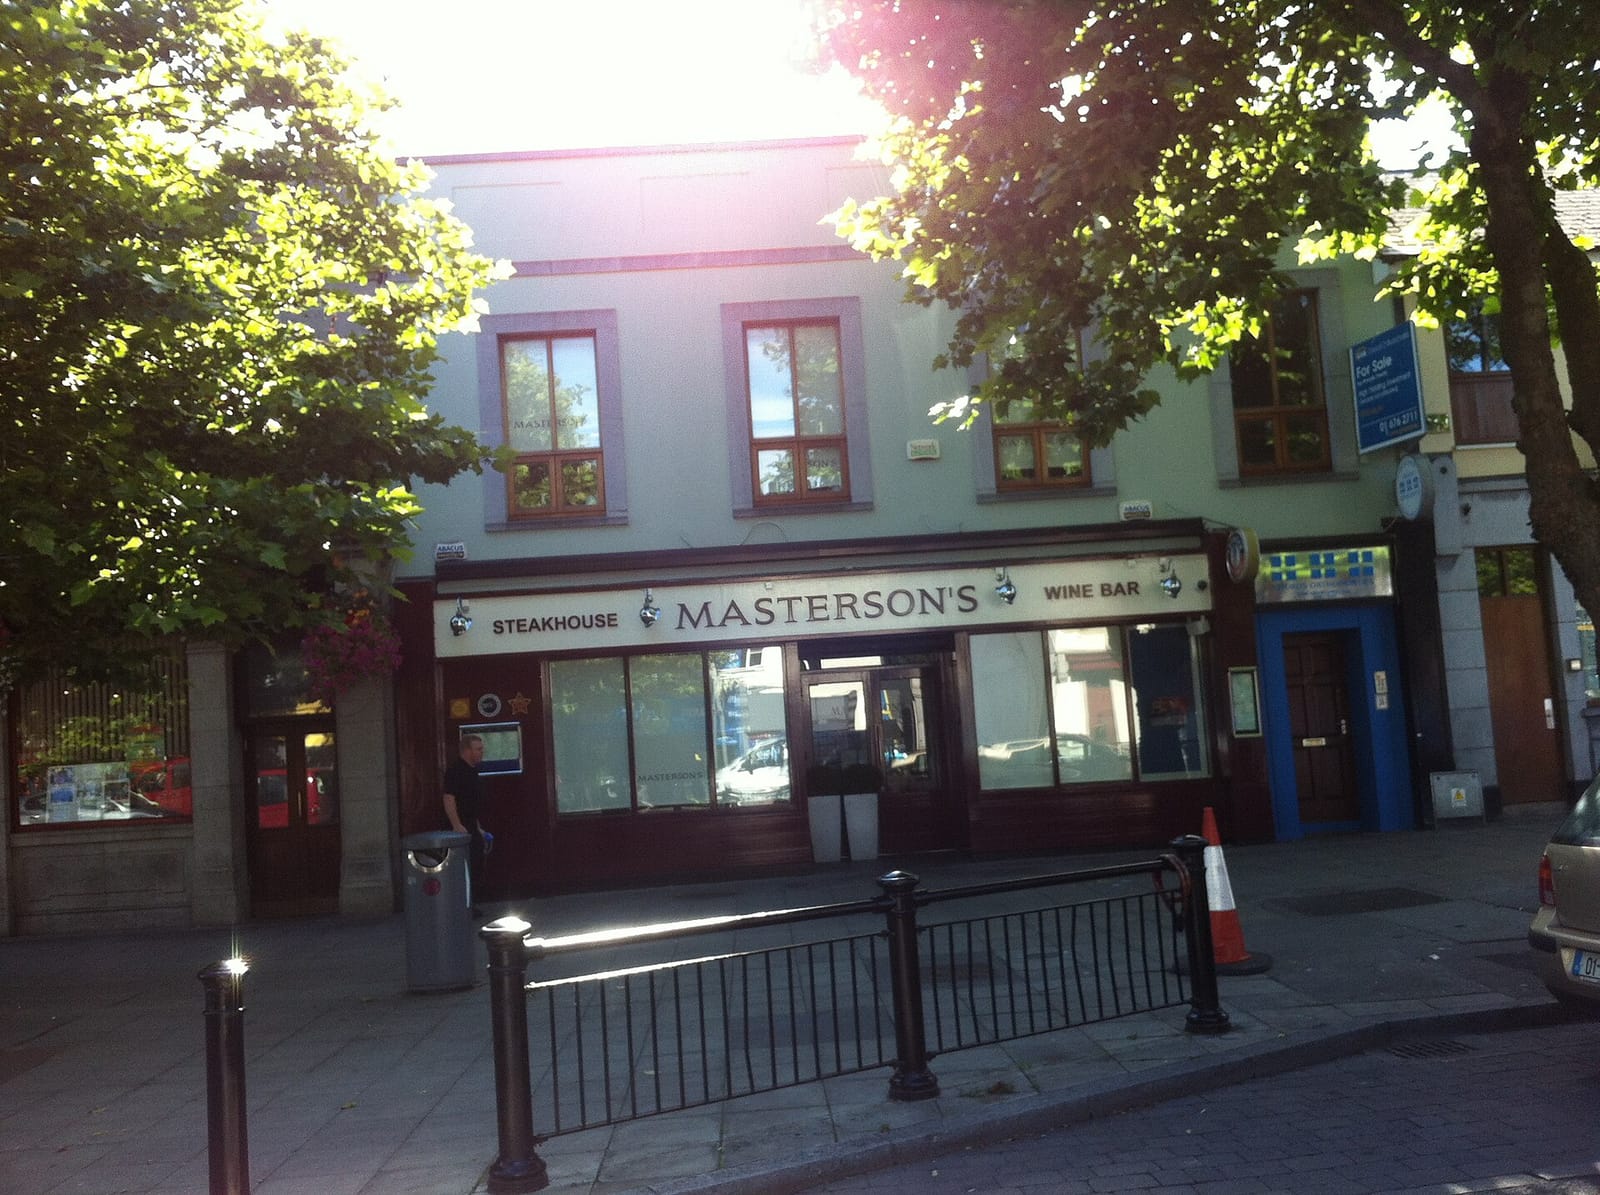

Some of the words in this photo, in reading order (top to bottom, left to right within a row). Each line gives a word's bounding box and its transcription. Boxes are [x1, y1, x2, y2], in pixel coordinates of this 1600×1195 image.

[1356, 365, 1370, 379] For
[1371, 355, 1393, 373] Sale
[438, 544, 464, 552] ABACUS
[1044, 584, 1094, 600] WINE
[1100, 581, 1140, 597] BAR
[675, 585, 978, 629] MASTERSON'S
[493, 613, 619, 635] STEAKHOUSE
